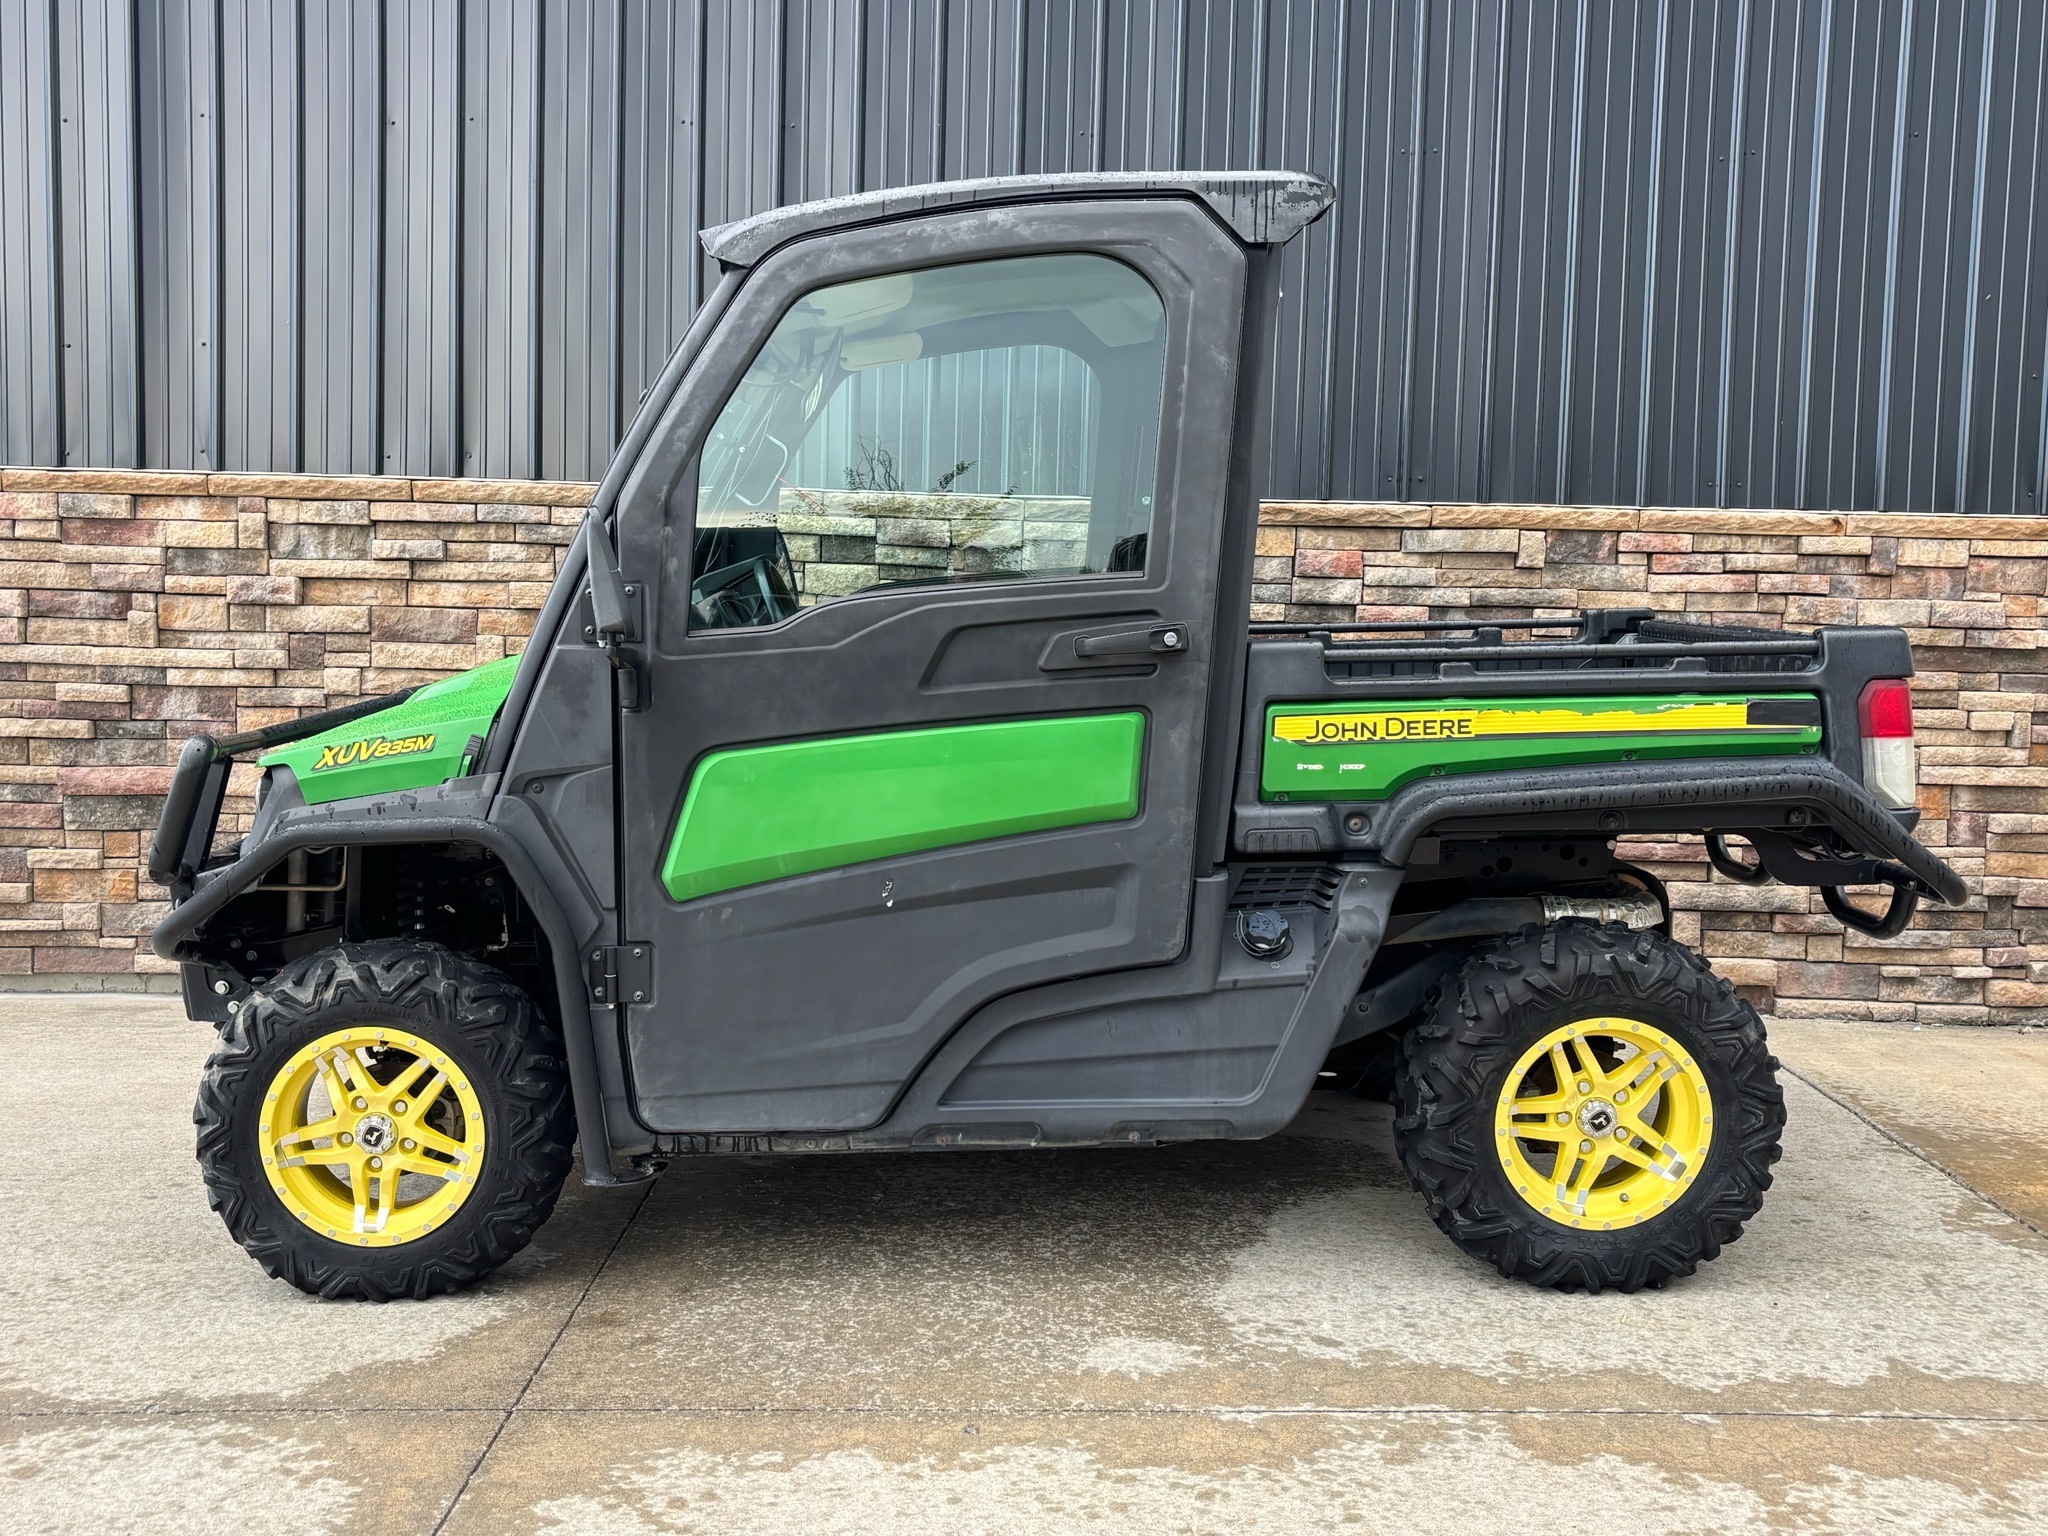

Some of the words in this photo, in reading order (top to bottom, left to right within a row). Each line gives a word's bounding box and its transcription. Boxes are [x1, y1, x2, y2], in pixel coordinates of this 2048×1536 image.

[1305, 720, 1378, 740] JOHN
[1385, 717, 1473, 737] DEERE
[311, 734, 436, 771] XUV835M
